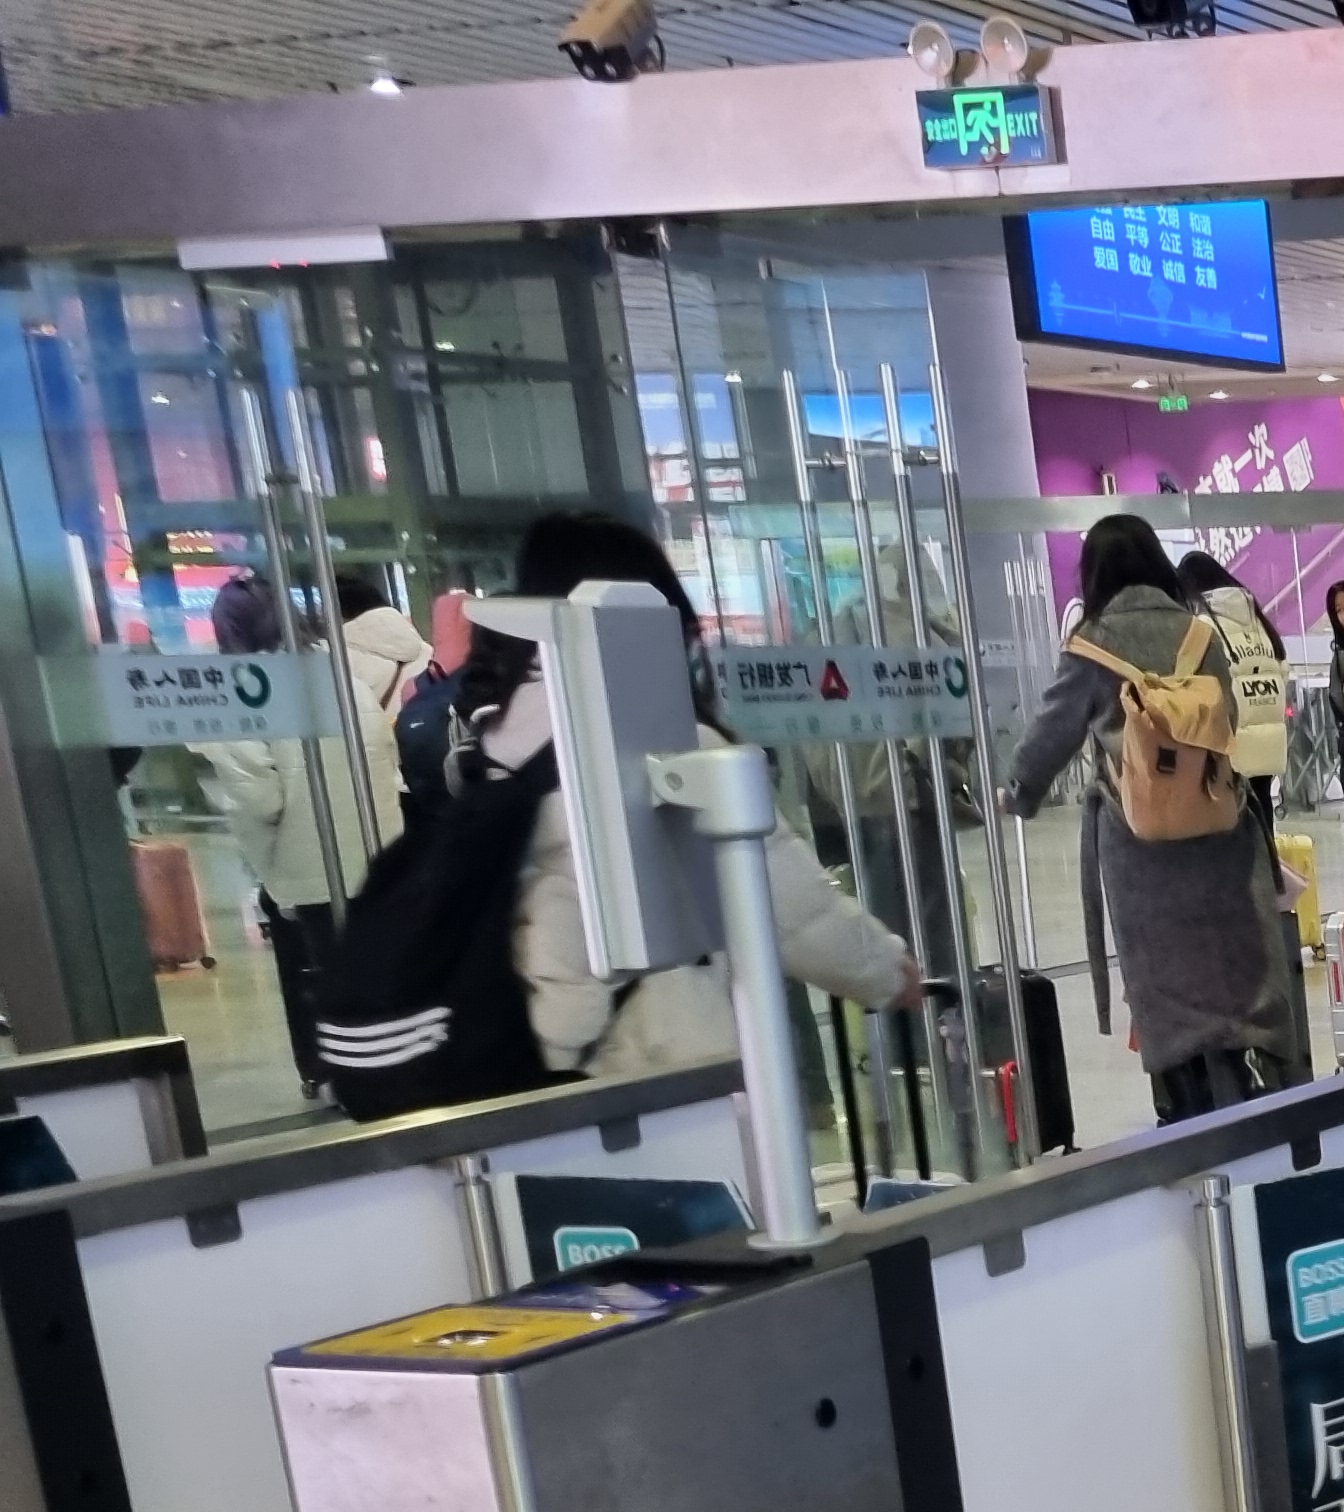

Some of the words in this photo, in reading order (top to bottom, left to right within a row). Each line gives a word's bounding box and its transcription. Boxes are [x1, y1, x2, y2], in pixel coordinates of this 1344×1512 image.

[1006, 111, 1038, 138] EXIT
[1090, 215, 1115, 242] 自由
[1125, 223, 1149, 249] 平等
[1160, 231, 1183, 255] 公正
[1192, 237, 1215, 261] 法治
[1093, 246, 1119, 272] 爱国
[1128, 252, 1153, 278] 敬业
[1163, 258, 1186, 284] 诚信
[1194, 265, 1217, 290] 友善
[1241, 679, 1280, 698] LYON
